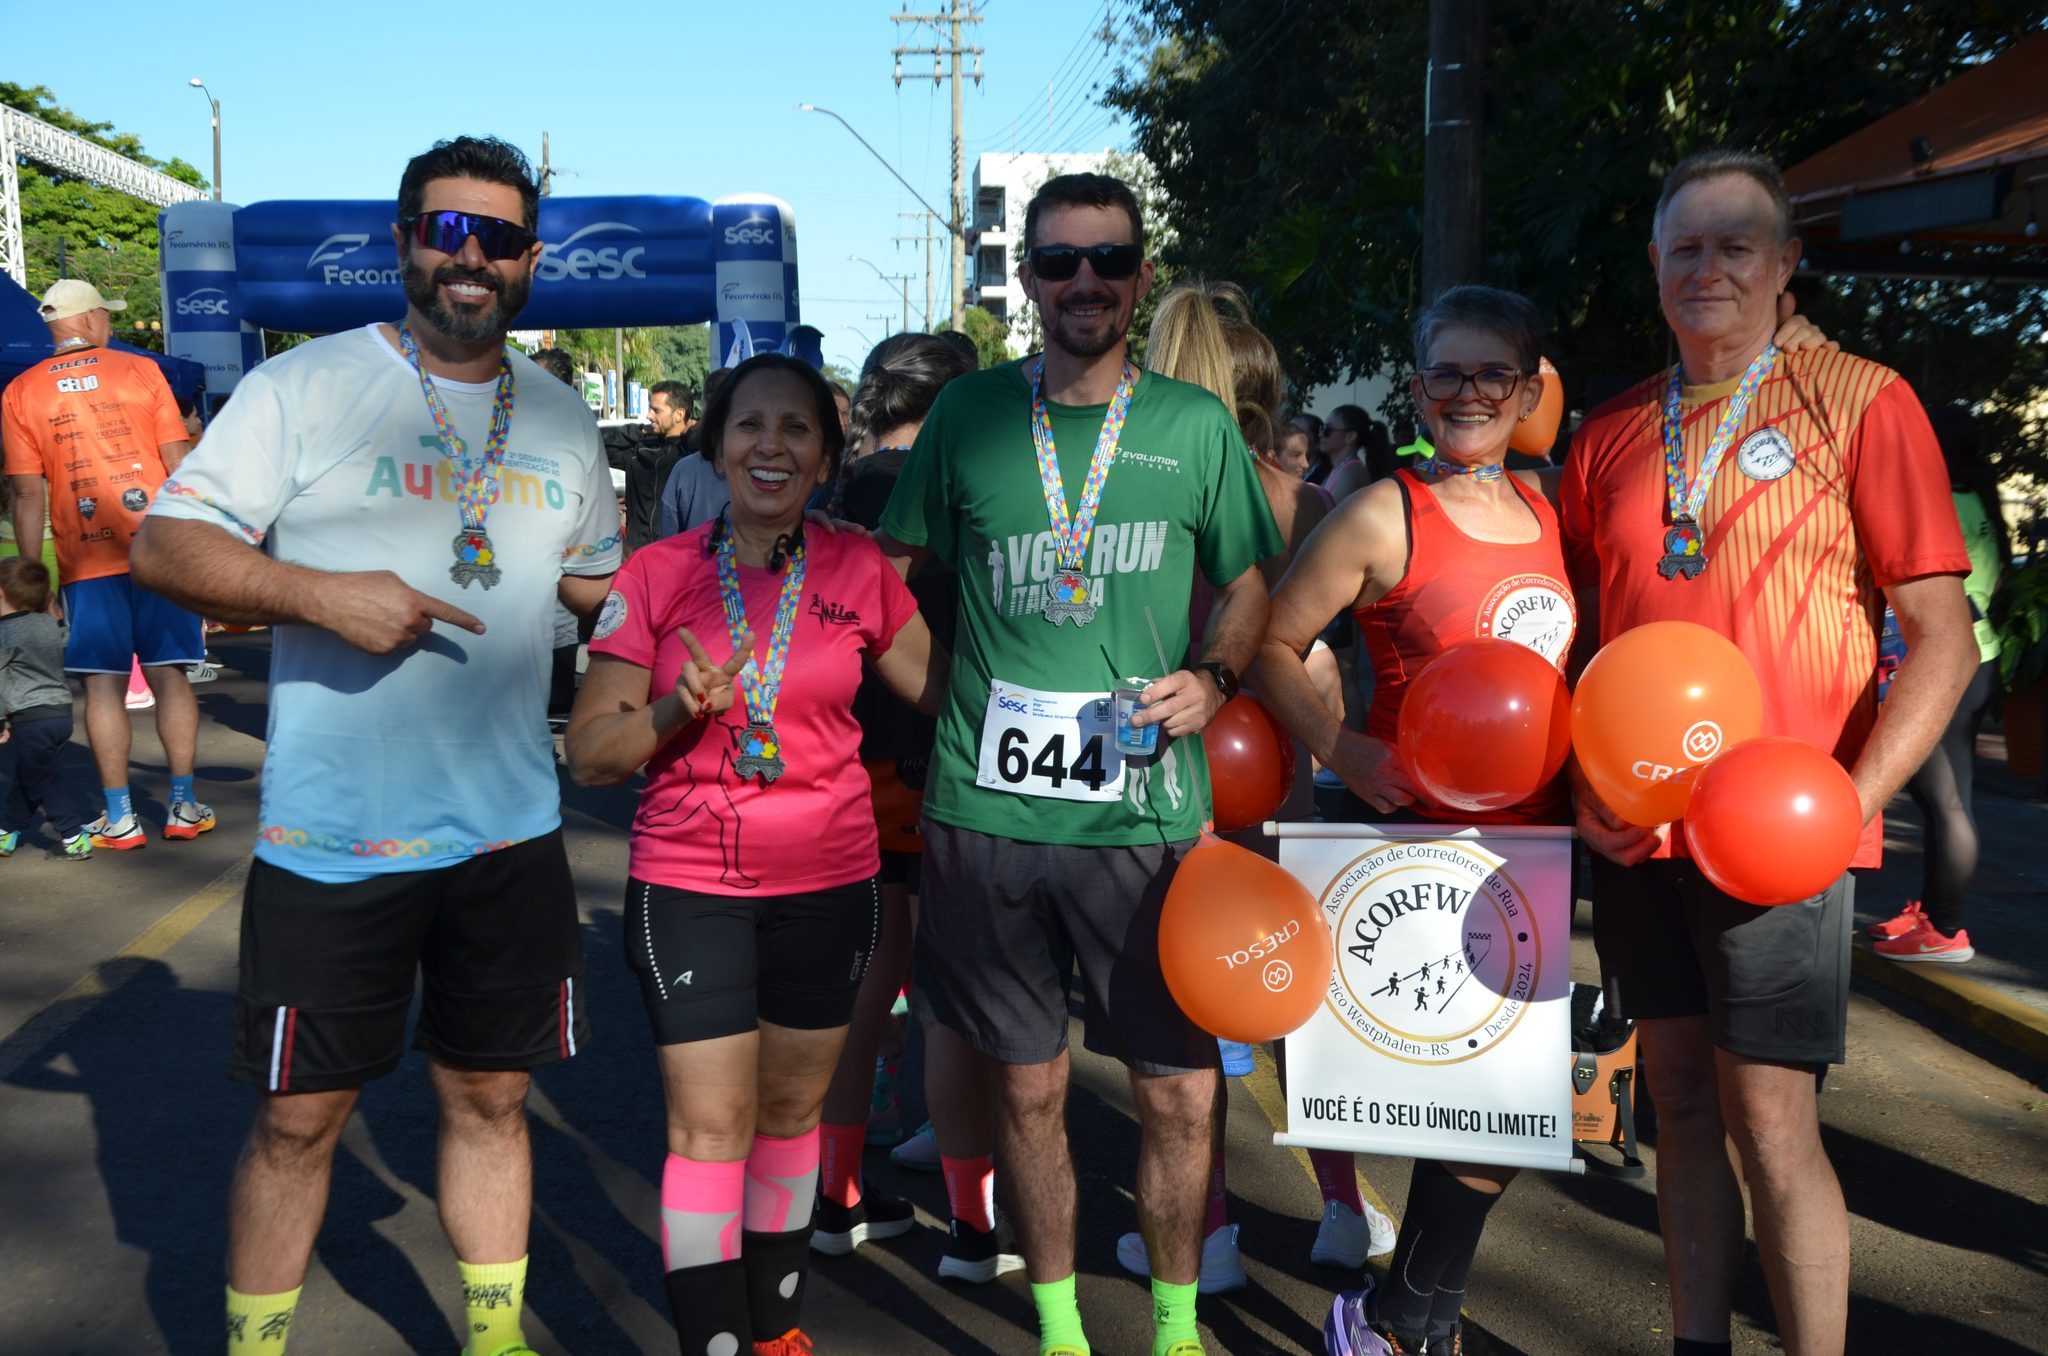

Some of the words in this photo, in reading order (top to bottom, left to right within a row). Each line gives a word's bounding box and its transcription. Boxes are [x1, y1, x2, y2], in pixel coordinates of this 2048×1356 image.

[169, 239, 217, 250] Fecomércio
[218, 240, 231, 250] RS
[724, 225, 775, 245] Sesc
[535, 243, 647, 281] Sesc
[176, 297, 230, 315] Sesc
[724, 292, 771, 301] Fecomércio
[772, 292, 783, 301] RS
[48, 356, 99, 374] ATLETA
[227, 363, 240, 373] RS
[56, 373, 99, 394] CÉLIO
[109, 470, 144, 482] PEROTTI
[1121, 458, 1181, 474] FITNESS
[1090, 520, 1168, 576] RUN
[1483, 582, 1511, 617] Associação
[1511, 578, 1521, 588] de
[1520, 576, 1561, 594] Corredores
[1560, 588, 1569, 601] de
[1497, 595, 1558, 640] ACORFW
[998, 696, 1028, 714] Sesc
[997, 726, 1107, 791] 644
[1325, 853, 1385, 915] Associação
[1387, 847, 1404, 863] de
[1406, 845, 1487, 878] Corredores
[1485, 872, 1502, 893] de
[1497, 887, 1519, 919] Rua
[1347, 882, 1472, 966] ACORFW
[1215, 919, 1300, 970] CRESOL
[1483, 1000, 1520, 1039] Desde
[1513, 961, 1534, 1001] 2024
[1301, 1095, 1348, 1122] VOCÊ
[1353, 1096, 1364, 1123] É
[1369, 1102, 1381, 1125] O
[1386, 1103, 1420, 1127] SEU
[1426, 1101, 1482, 1133] ÚNICO
[1487, 1111, 1557, 1139] LIMITE!
